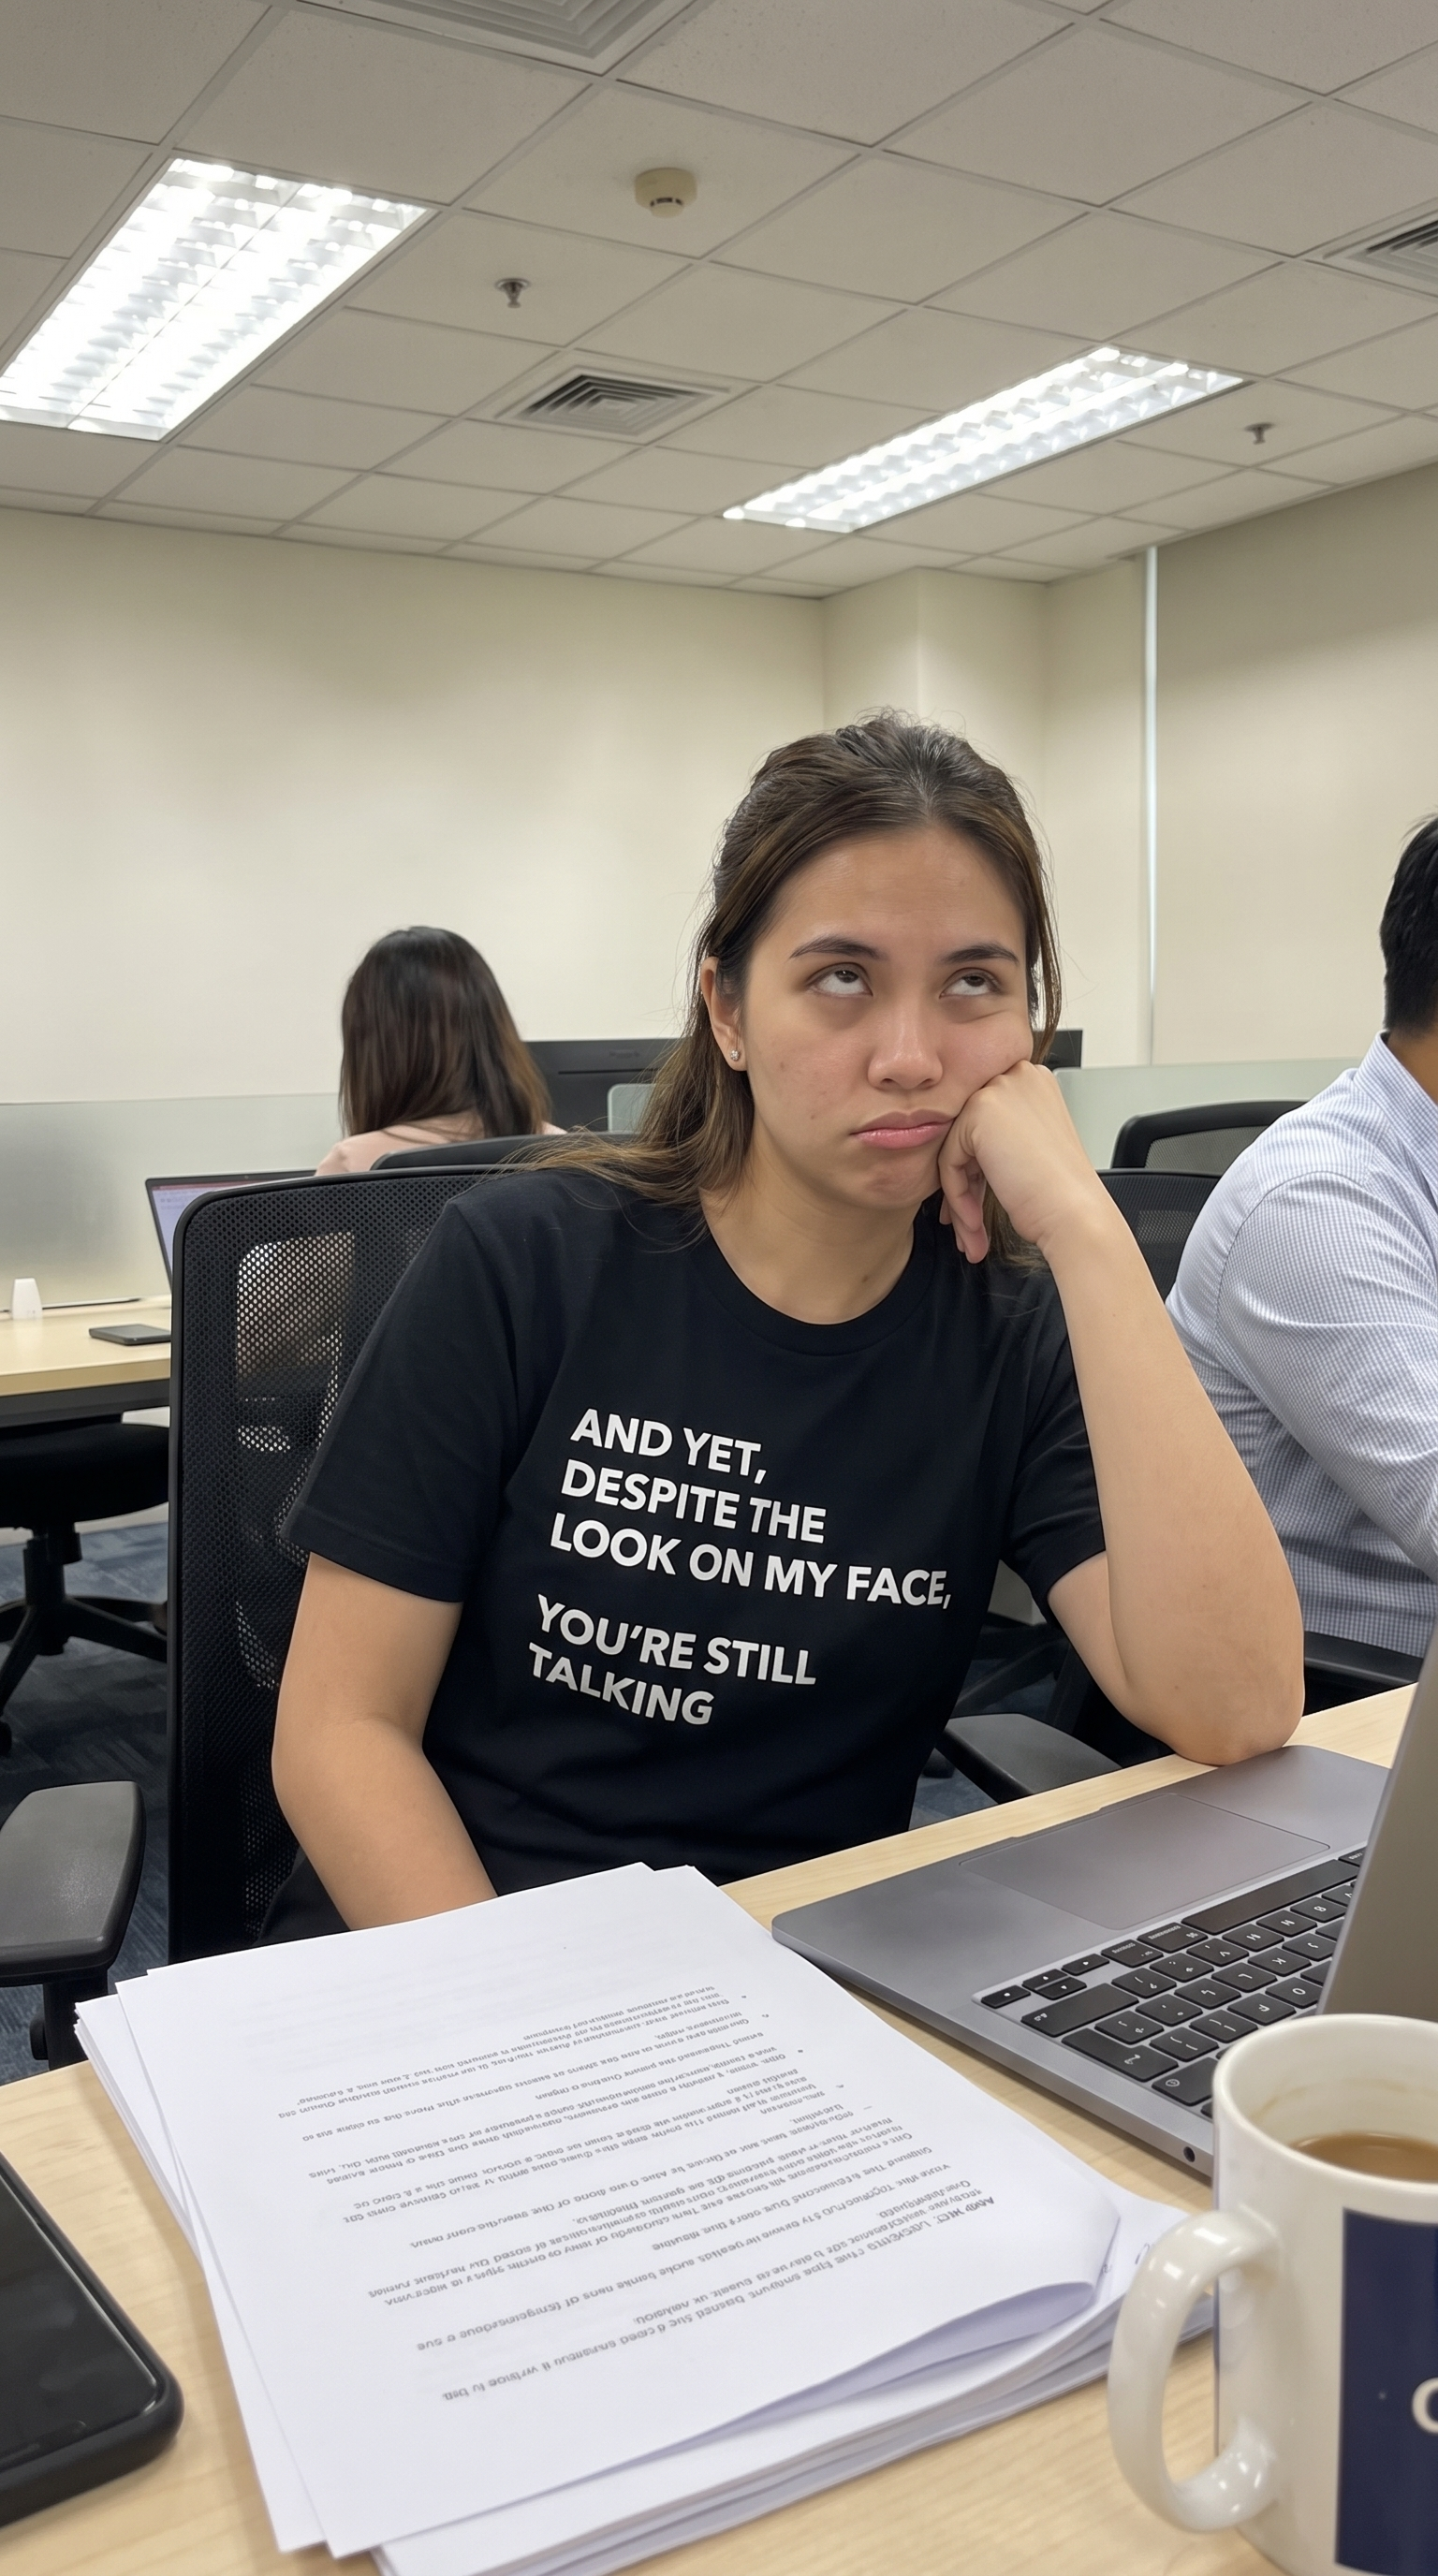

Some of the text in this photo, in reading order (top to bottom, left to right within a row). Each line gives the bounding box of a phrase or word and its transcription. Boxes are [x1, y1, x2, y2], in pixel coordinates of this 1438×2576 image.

[569, 1408, 767, 1485] AND YET,
[561, 1458, 827, 1544] DESPITE THE
[550, 1512, 951, 1610] LOOK ON MY FACE,
[537, 1593, 816, 1685] YOU’RE STILL
[528, 1642, 715, 1725] TALKING
